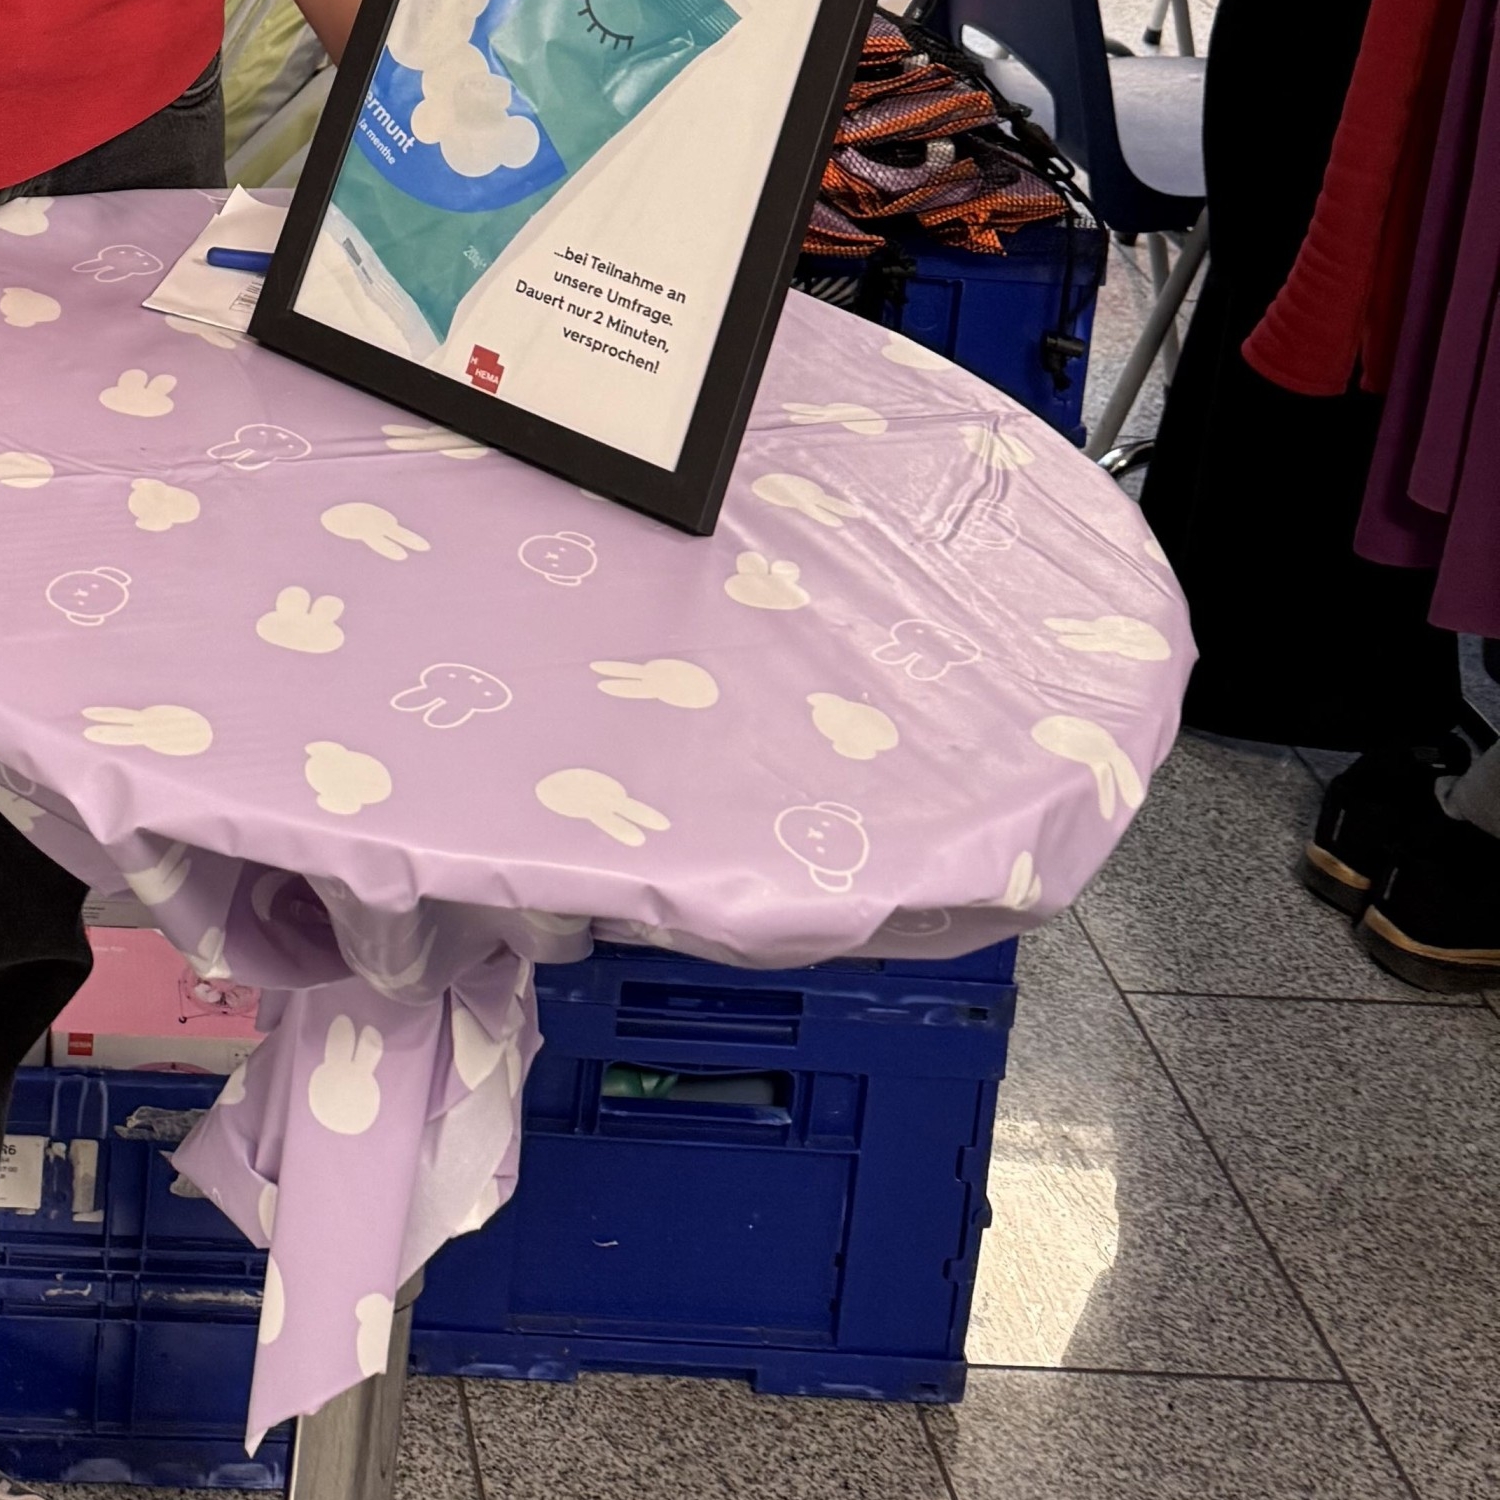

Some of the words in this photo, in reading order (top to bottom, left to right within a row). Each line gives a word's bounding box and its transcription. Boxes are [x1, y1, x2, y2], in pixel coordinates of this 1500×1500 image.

[364, 91, 415, 154] ermunt
[366, 129, 396, 165] menthe
[553, 271, 603, 298] unsere
[606, 288, 673, 326] Umfrage.
[591, 255, 664, 295] Teilnahme
[666, 287, 687, 304] an
[515, 279, 565, 310] Dauert
[566, 302, 593, 320] nur
[592, 311, 604, 325] 2
[606, 315, 670, 353] Minuten,
[562, 326, 660, 374] versprochen!
[475, 368, 499, 385] HEMA
